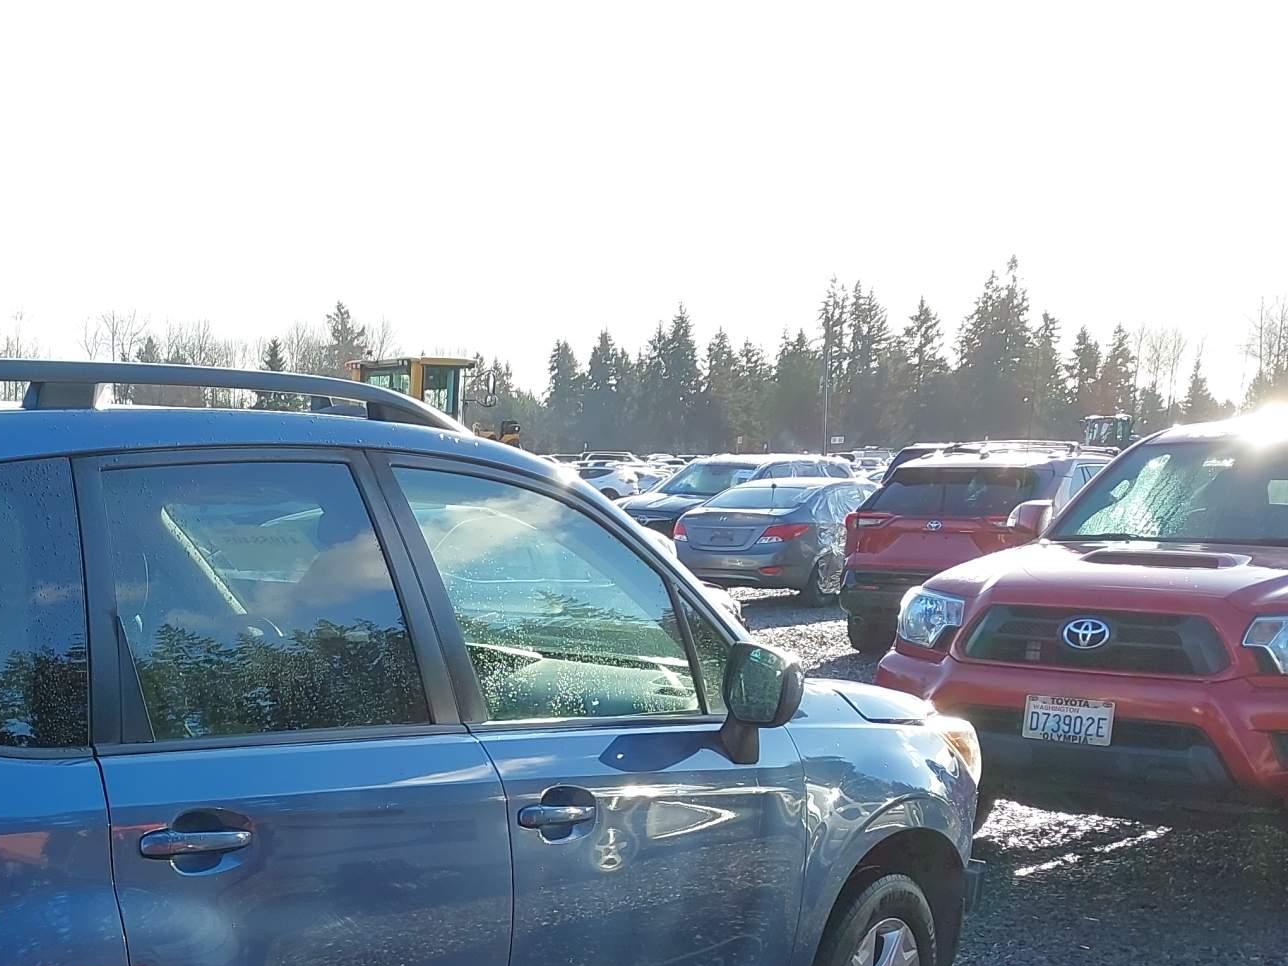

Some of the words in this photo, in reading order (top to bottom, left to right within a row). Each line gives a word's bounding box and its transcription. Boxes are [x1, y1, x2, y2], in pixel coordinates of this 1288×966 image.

[1051, 697, 1090, 708] TOYOTA
[1033, 704, 1080, 714] WASHINGTON
[1029, 711, 1107, 738] D73902E
